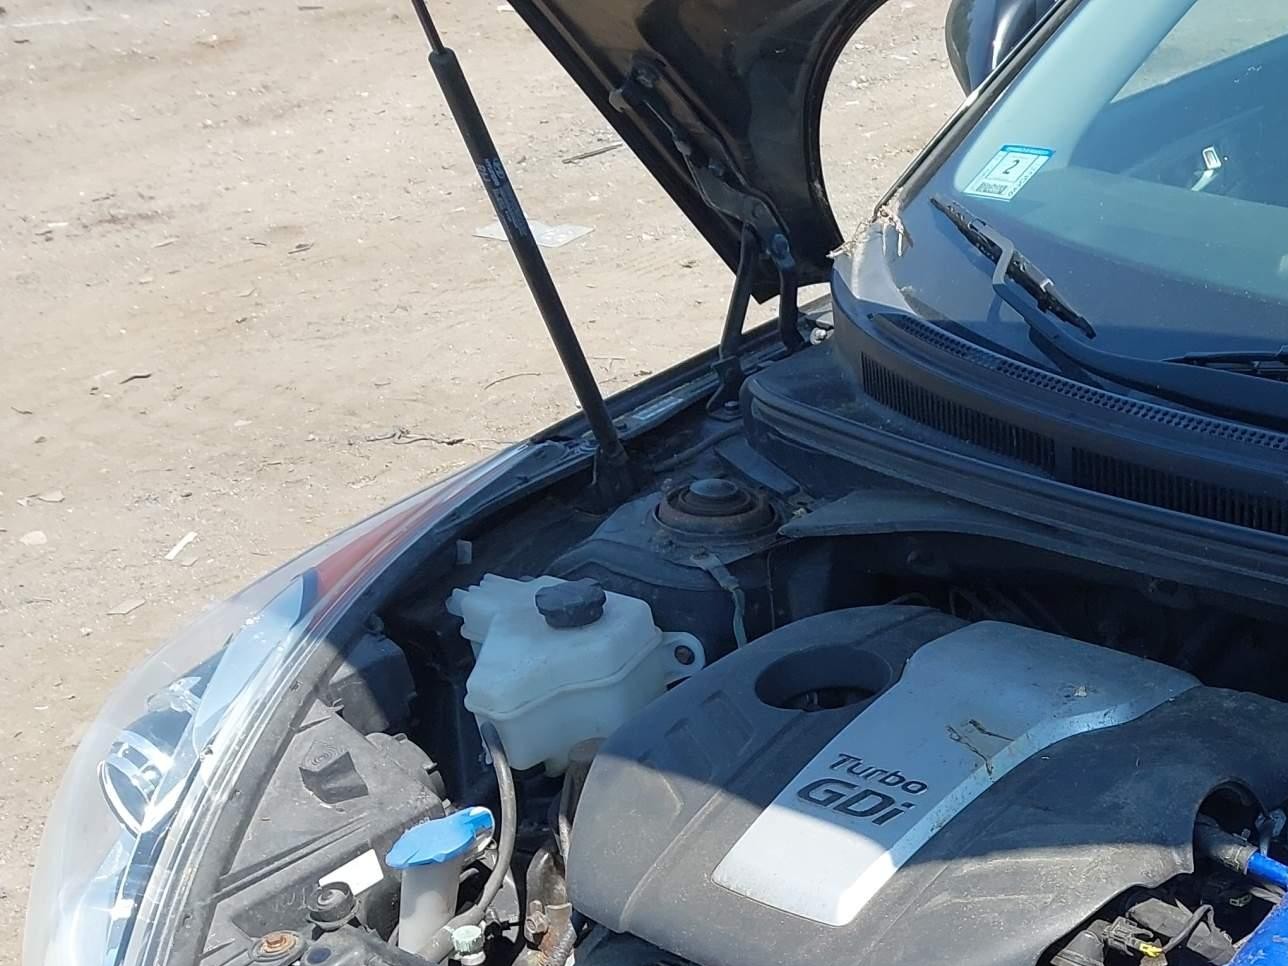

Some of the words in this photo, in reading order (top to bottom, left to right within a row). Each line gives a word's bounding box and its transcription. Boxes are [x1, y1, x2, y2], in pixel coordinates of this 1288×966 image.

[1002, 159, 1020, 175] 2
[829, 752, 928, 795] Turbo
[797, 778, 916, 826] GDi
